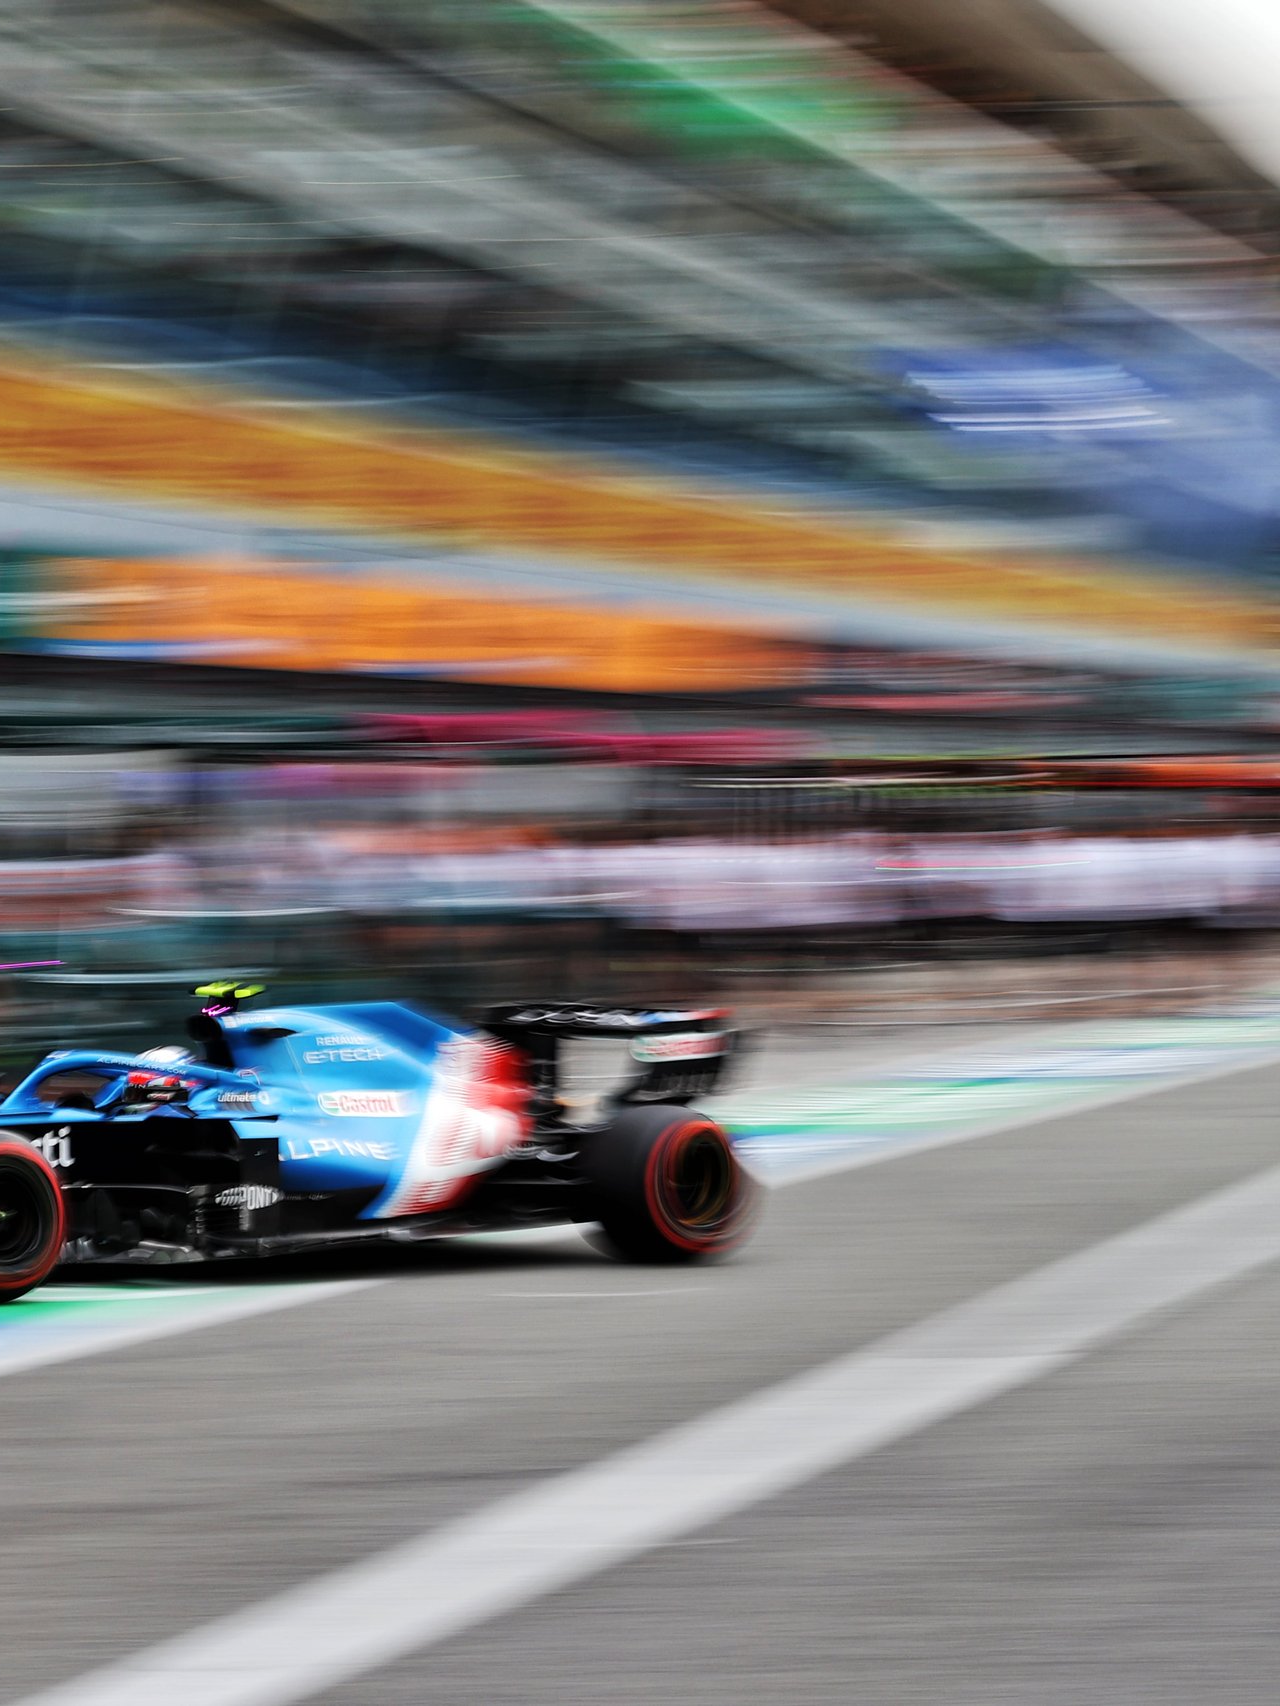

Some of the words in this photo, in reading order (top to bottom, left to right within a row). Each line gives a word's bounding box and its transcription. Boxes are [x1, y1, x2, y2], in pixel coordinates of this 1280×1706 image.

[304, 1049, 382, 1064] E-TECH
[339, 1094, 398, 1114] Castrol
[278, 1138, 393, 1161] LPINE
